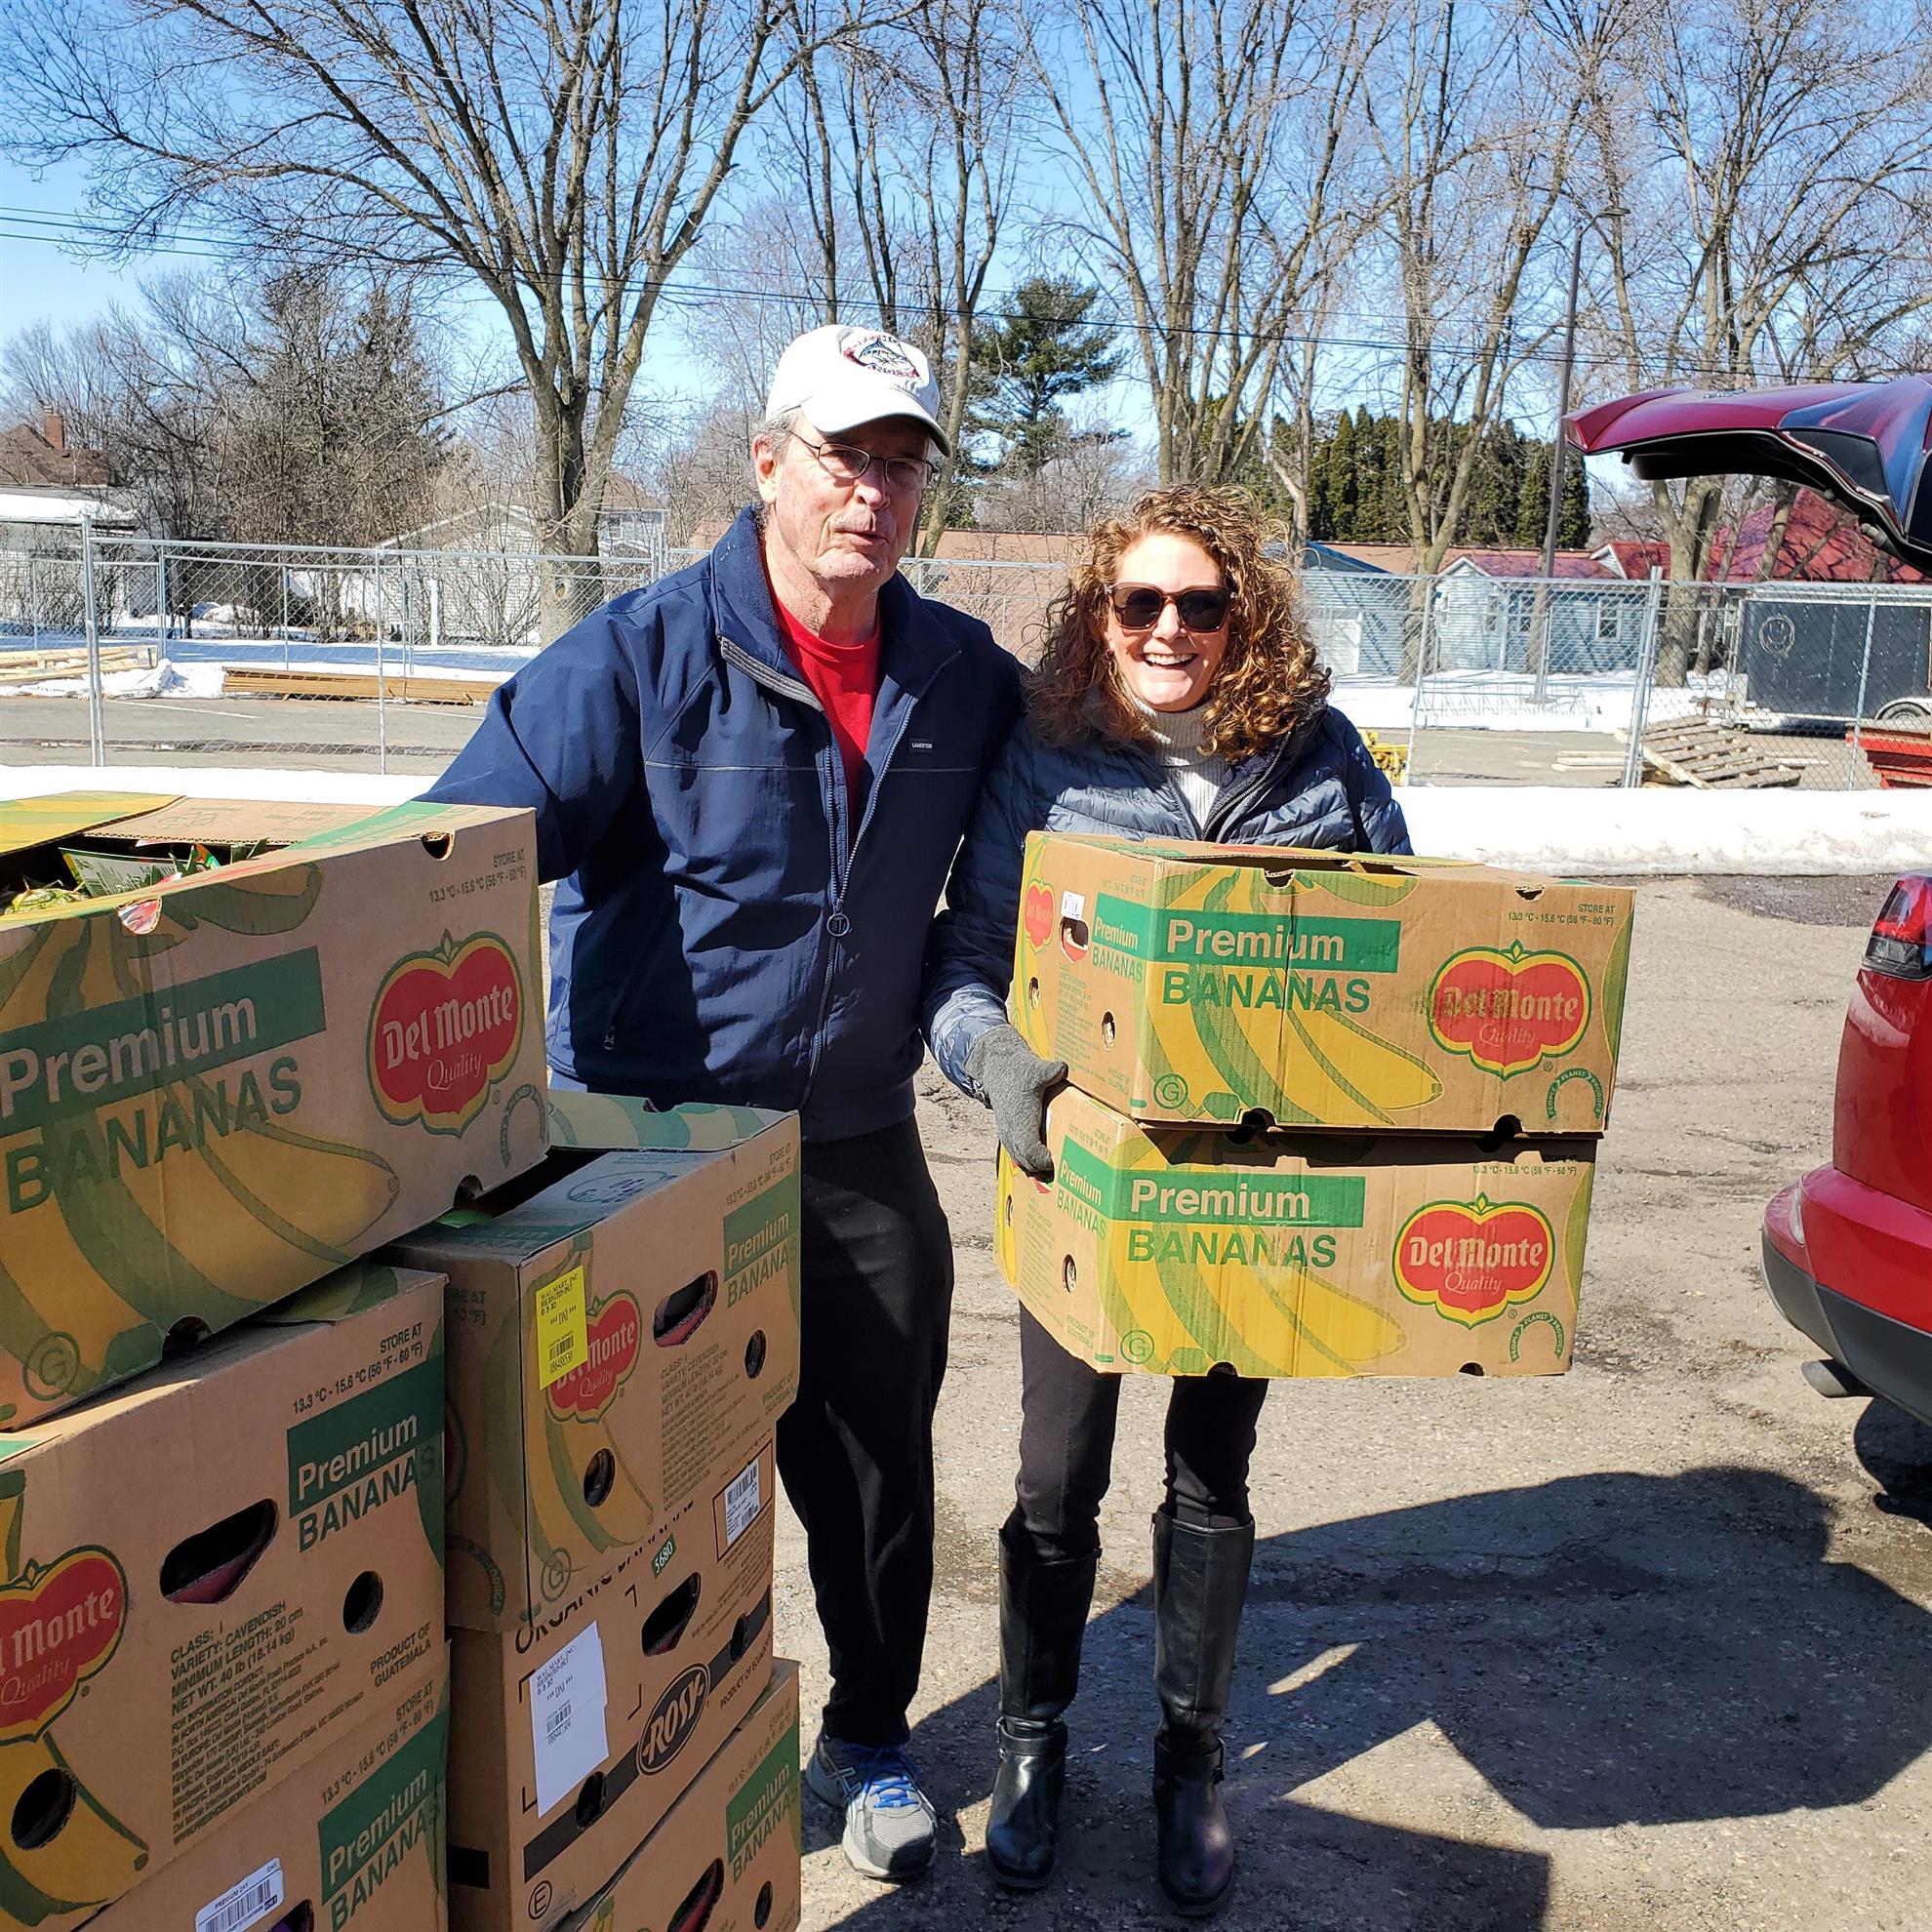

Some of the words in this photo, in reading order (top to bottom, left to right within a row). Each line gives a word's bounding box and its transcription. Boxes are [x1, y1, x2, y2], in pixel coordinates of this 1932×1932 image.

[493, 851, 516, 868] STORE
[516, 848, 526, 862] AT
[1578, 903, 1603, 913] STORE
[1604, 905, 1616, 914] AT
[1095, 917, 1139, 950] Premium
[1166, 918, 1345, 962] Premium
[1093, 946, 1144, 984] BANANAS
[1162, 969, 1371, 1014] BANANAS
[1443, 986, 1486, 1019] Del
[1493, 988, 1580, 1022] Monte
[383, 1009, 432, 1070] Del
[433, 985, 514, 1050] Monte
[1477, 1024, 1537, 1048] Quality
[0, 994, 258, 1120] Premium
[427, 1053, 482, 1091] Quality
[5, 1055, 303, 1215] BANANAS
[1060, 1159, 1102, 1206] Premium
[1130, 1178, 1309, 1219] Premium
[1057, 1188, 1107, 1240] BANANAS
[728, 1212, 789, 1270] Premium
[1127, 1228, 1337, 1268] BANANAS
[1408, 1235, 1453, 1268] Del
[1458, 1236, 1544, 1268] Monte
[1444, 1271, 1503, 1296] Quality
[380, 1326, 411, 1353] STORE
[411, 1323, 423, 1339] AT
[587, 1320, 635, 1372] Monte
[293, 1395, 313, 1414] 13.3
[335, 1375, 354, 1393] 15.6
[368, 1361, 382, 1382] (56
[399, 1348, 410, 1364] 60
[580, 1367, 613, 1397] Quality
[299, 1414, 419, 1501] Premium
[300, 1444, 437, 1553] BANANAS
[654, 1540, 674, 1575] 5680
[12, 1588, 114, 1669] Monte
[171, 1640, 223, 1680] VARIETY:
[225, 1600, 287, 1647] CAVENDISH
[171, 1630, 214, 1664] CLASS:
[370, 1632, 417, 1674] PRODUCT
[418, 1622, 431, 1639] OF
[172, 1656, 222, 1699] MINIMUM
[225, 1627, 273, 1665] LENGTH:
[274, 1617, 287, 1633] 20
[288, 1607, 304, 1624] cm
[172, 1693, 195, 1717] NET
[198, 1678, 218, 1700] WT.
[220, 1668, 233, 1684] 40
[235, 1658, 246, 1674] lb
[247, 1639, 278, 1670] (18.14
[279, 1627, 295, 1646] kg)
[374, 1638, 432, 1688] GUATEMALA
[1, 1657, 70, 1706] Quality
[395, 1688, 424, 1722] STORE
[423, 1679, 433, 1700] AT
[642, 1670, 704, 1765] ROSY
[329, 1767, 428, 1887] Premium
[732, 1763, 790, 1852] Premium
